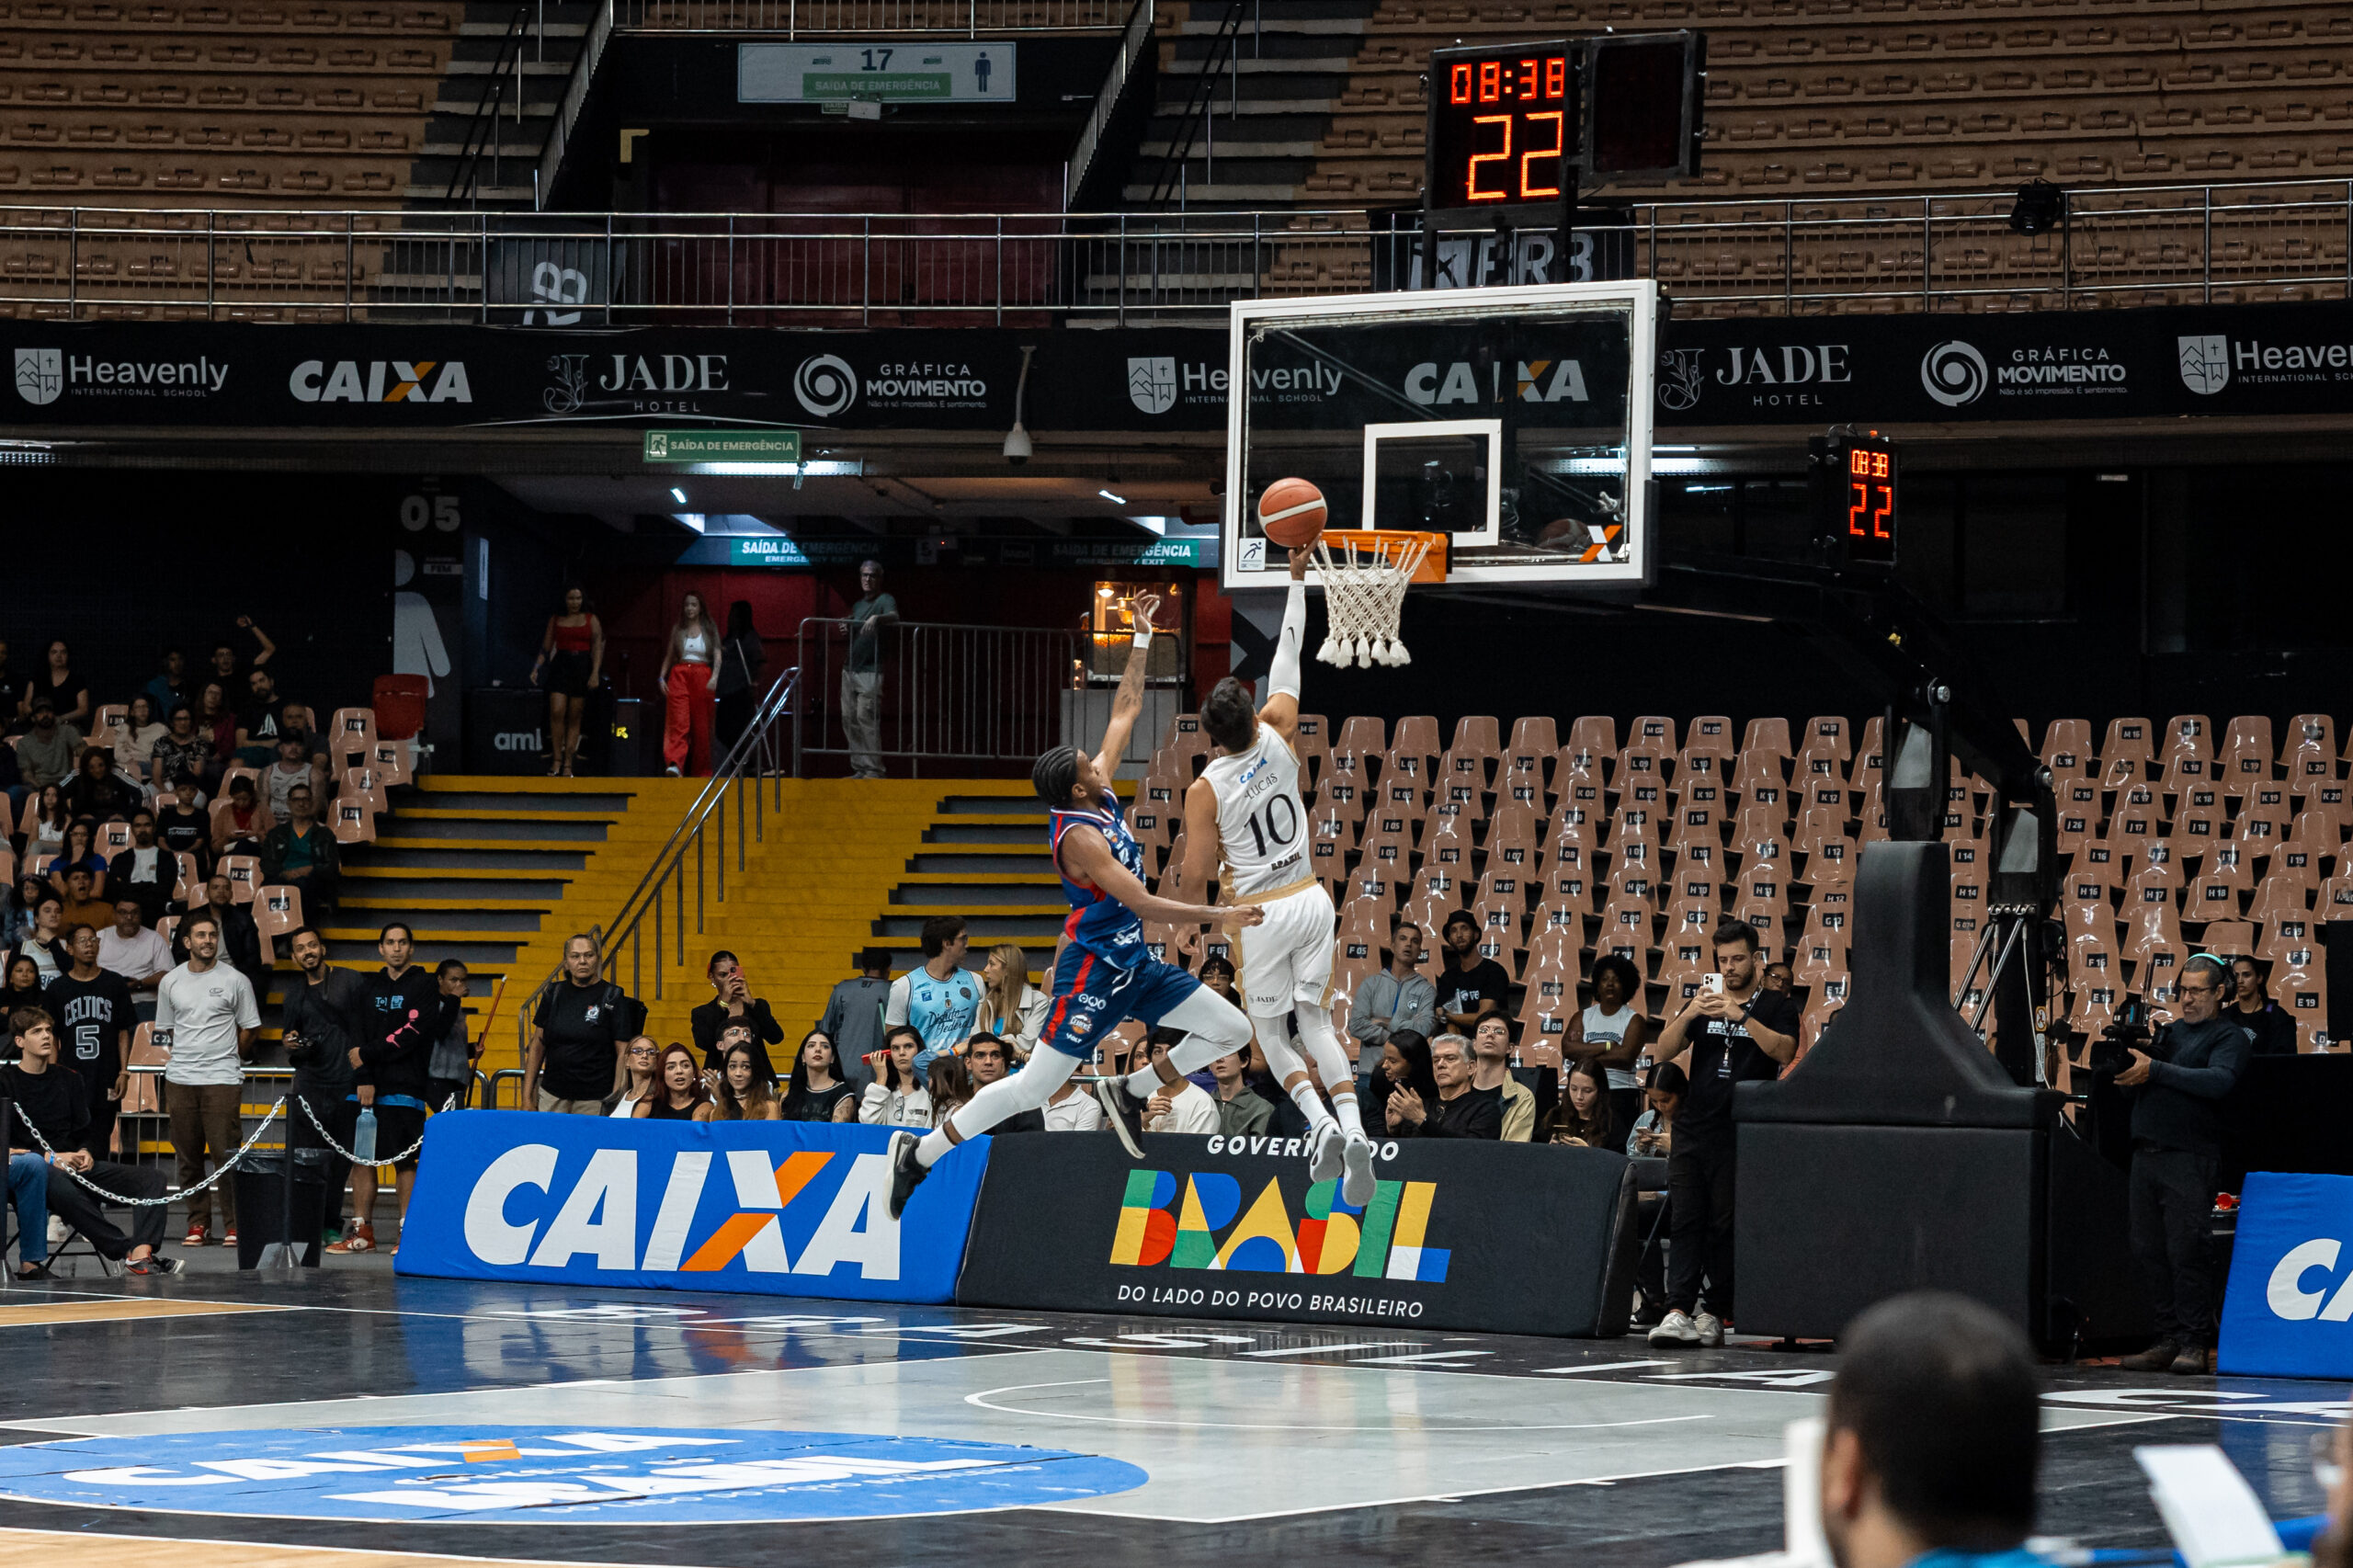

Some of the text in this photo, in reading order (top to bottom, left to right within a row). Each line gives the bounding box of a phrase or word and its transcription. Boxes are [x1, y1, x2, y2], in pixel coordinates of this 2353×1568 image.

[860, 49, 893, 71] 17
[850, 81, 863, 91] DE
[1449, 57, 1565, 104] 08:38
[1467, 110, 1563, 200] 22
[880, 362, 972, 377] GRÁFICA
[1716, 345, 1852, 385] JADE
[2012, 346, 2109, 362] GRÁFICA
[2234, 340, 2353, 370] Heave
[71, 355, 229, 392] Heavenly
[289, 359, 473, 403] CAIXA
[599, 354, 729, 392] JADE
[866, 379, 987, 397] MOVIMENTO
[1183, 360, 1343, 395] Hevenly
[1997, 364, 2126, 383] MOVIMENTO
[2238, 373, 2327, 383] INTERNATIONAL
[71, 388, 208, 398] INTERNATIONAL SCHOOL
[633, 401, 701, 413] HOTEL
[1278, 393, 1323, 403] SCHOOL
[1753, 393, 1823, 406] HOTEL
[1999, 388, 2016, 396] Não
[2024, 387, 2034, 395] só
[670, 437, 793, 452] SAÍDA DE EMERGÊNCIA
[400, 494, 460, 532] 05
[1849, 483, 1892, 538] 22
[741, 539, 779, 554] SAÍDA
[780, 540, 800, 554] DE
[1245, 773, 1279, 800] LUCAS
[1244, 794, 1297, 858] 10
[64, 995, 113, 1027] CELTICS
[75, 1025, 99, 1060] 5
[463, 1143, 902, 1280] CAIXA
[1109, 1168, 1451, 1283] BRASIL
[1117, 1285, 1424, 1318] DO LADO DO POVO BRASILEIRO
[63, 1432, 744, 1485] CAIXA
